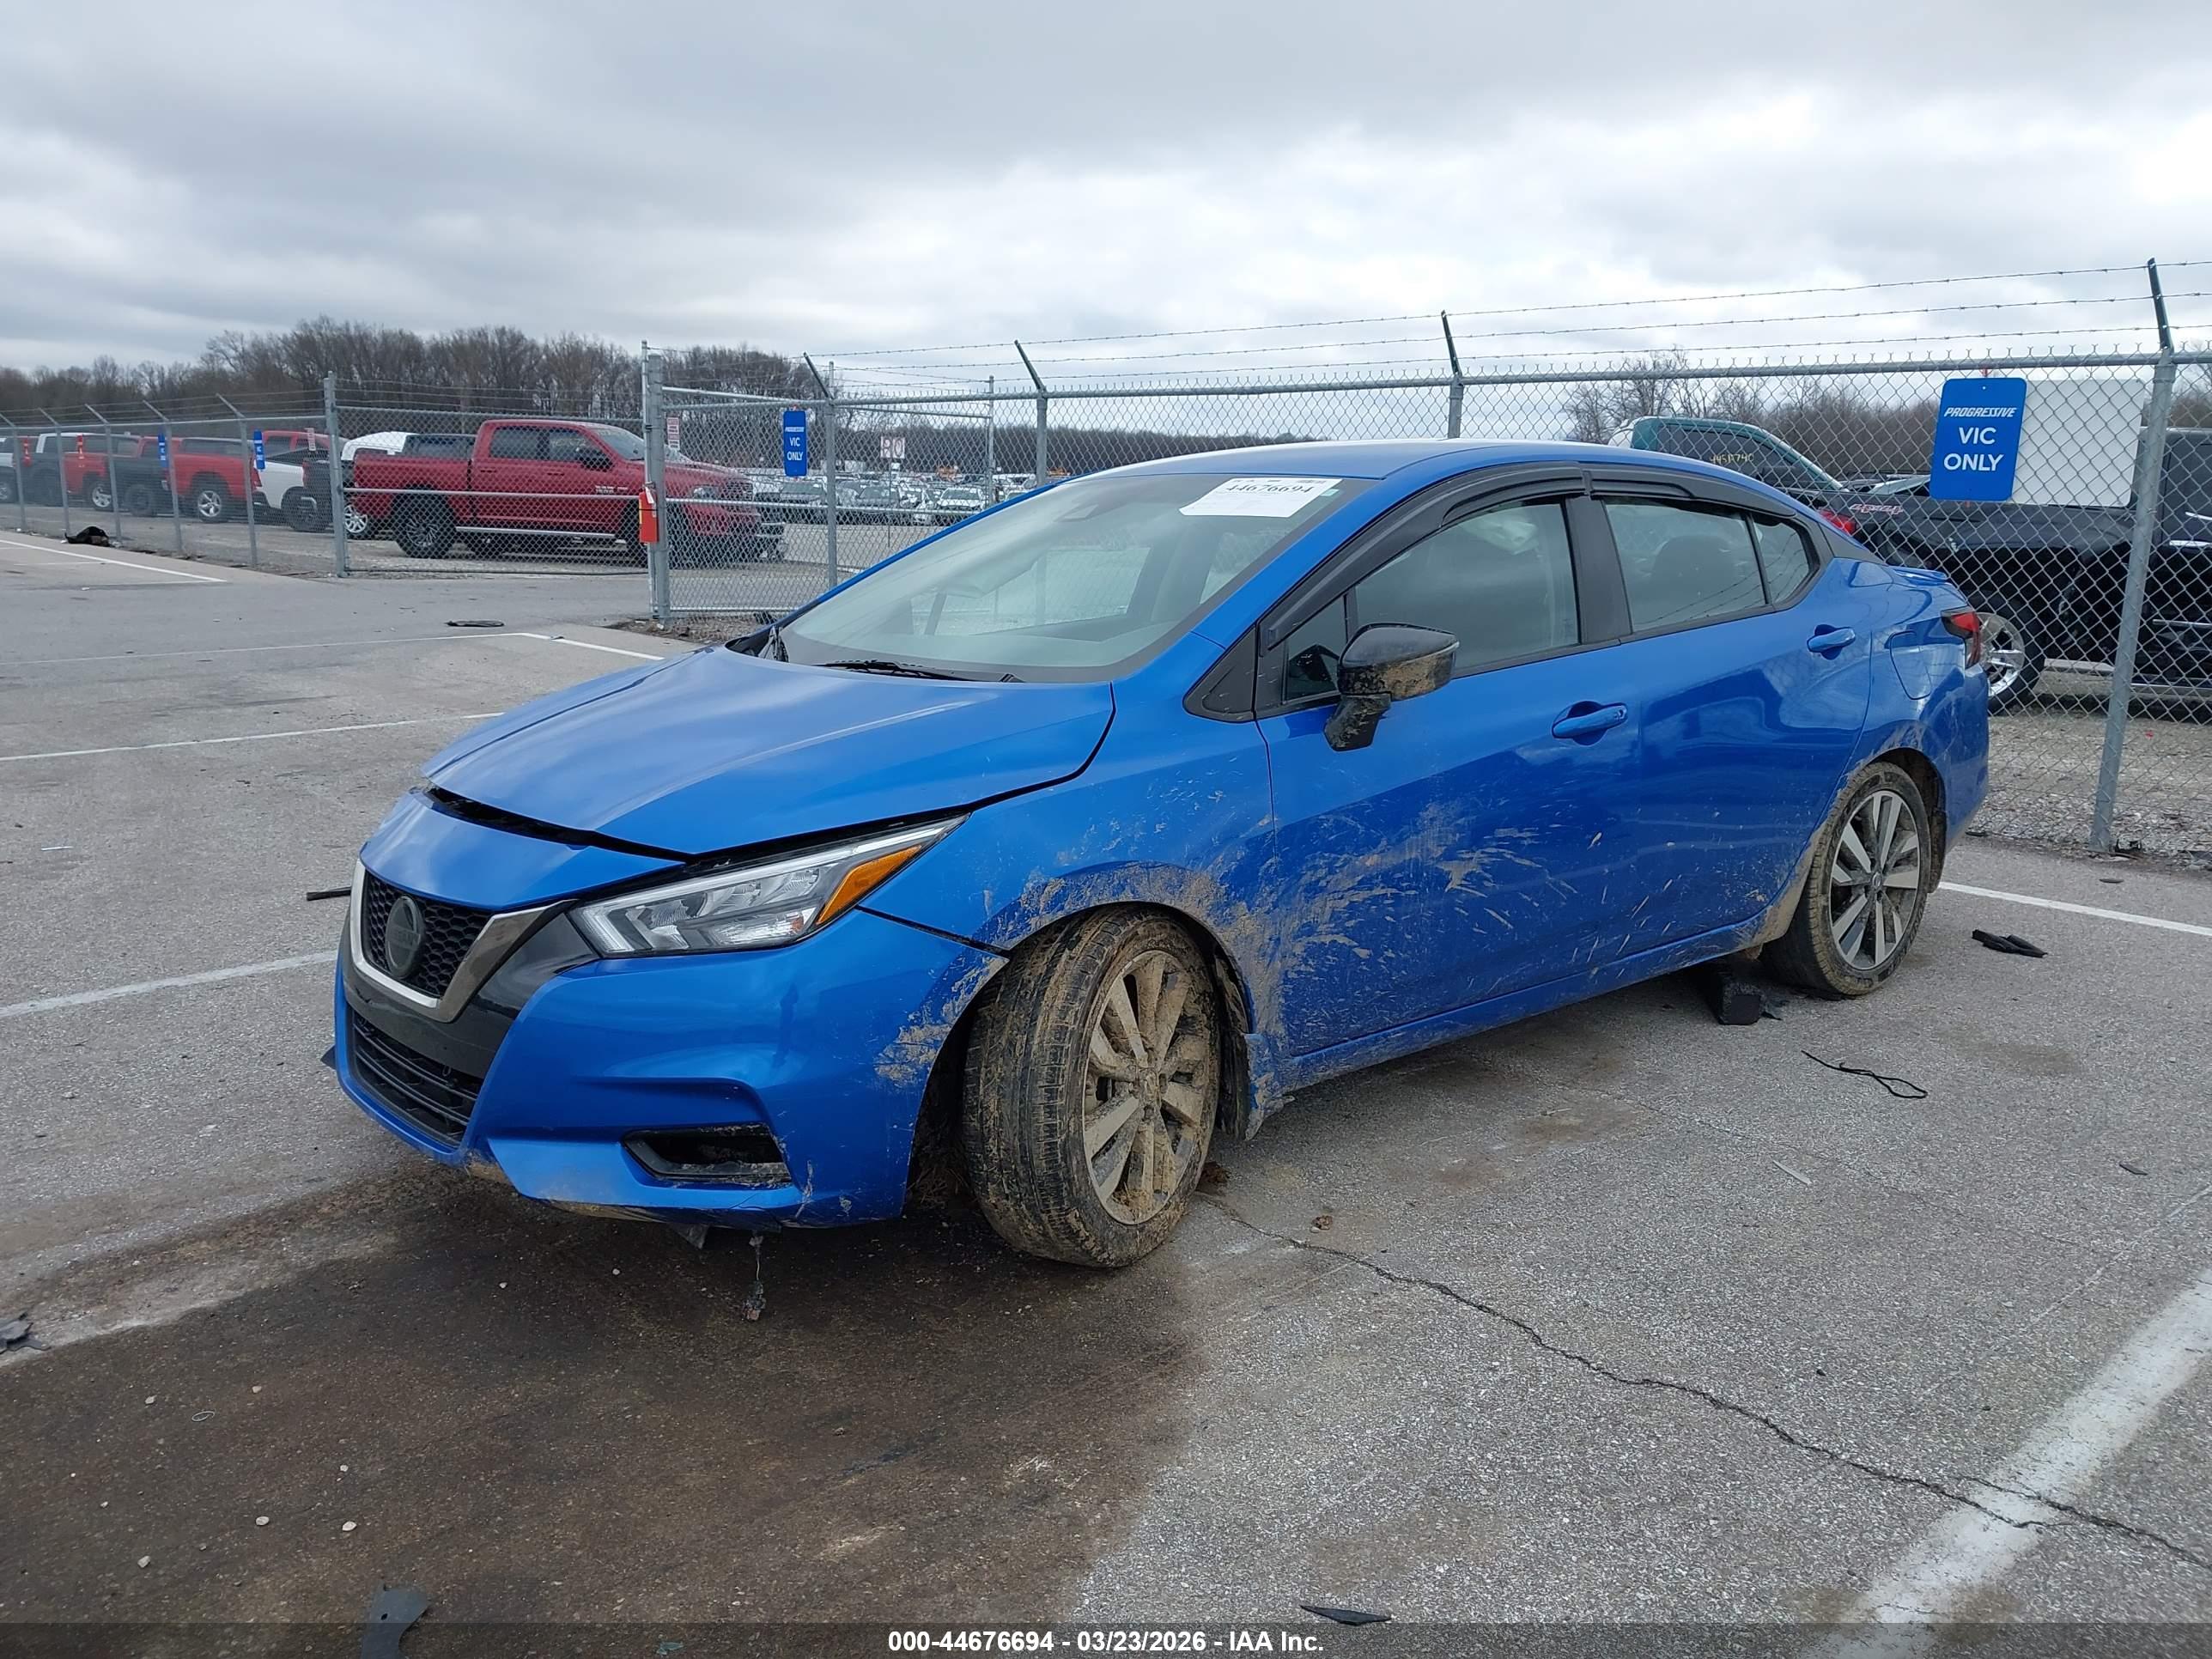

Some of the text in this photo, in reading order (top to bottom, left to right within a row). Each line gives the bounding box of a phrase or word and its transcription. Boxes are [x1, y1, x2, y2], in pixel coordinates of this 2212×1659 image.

[1944, 407, 2017, 417] PROGRESSIVE
[1959, 427, 1996, 445] VIC
[790, 437, 800, 447] VIC
[787, 452, 804, 461] ONLY
[1943, 453, 2004, 471] ONLY
[1226, 484, 1315, 493] 44676694
